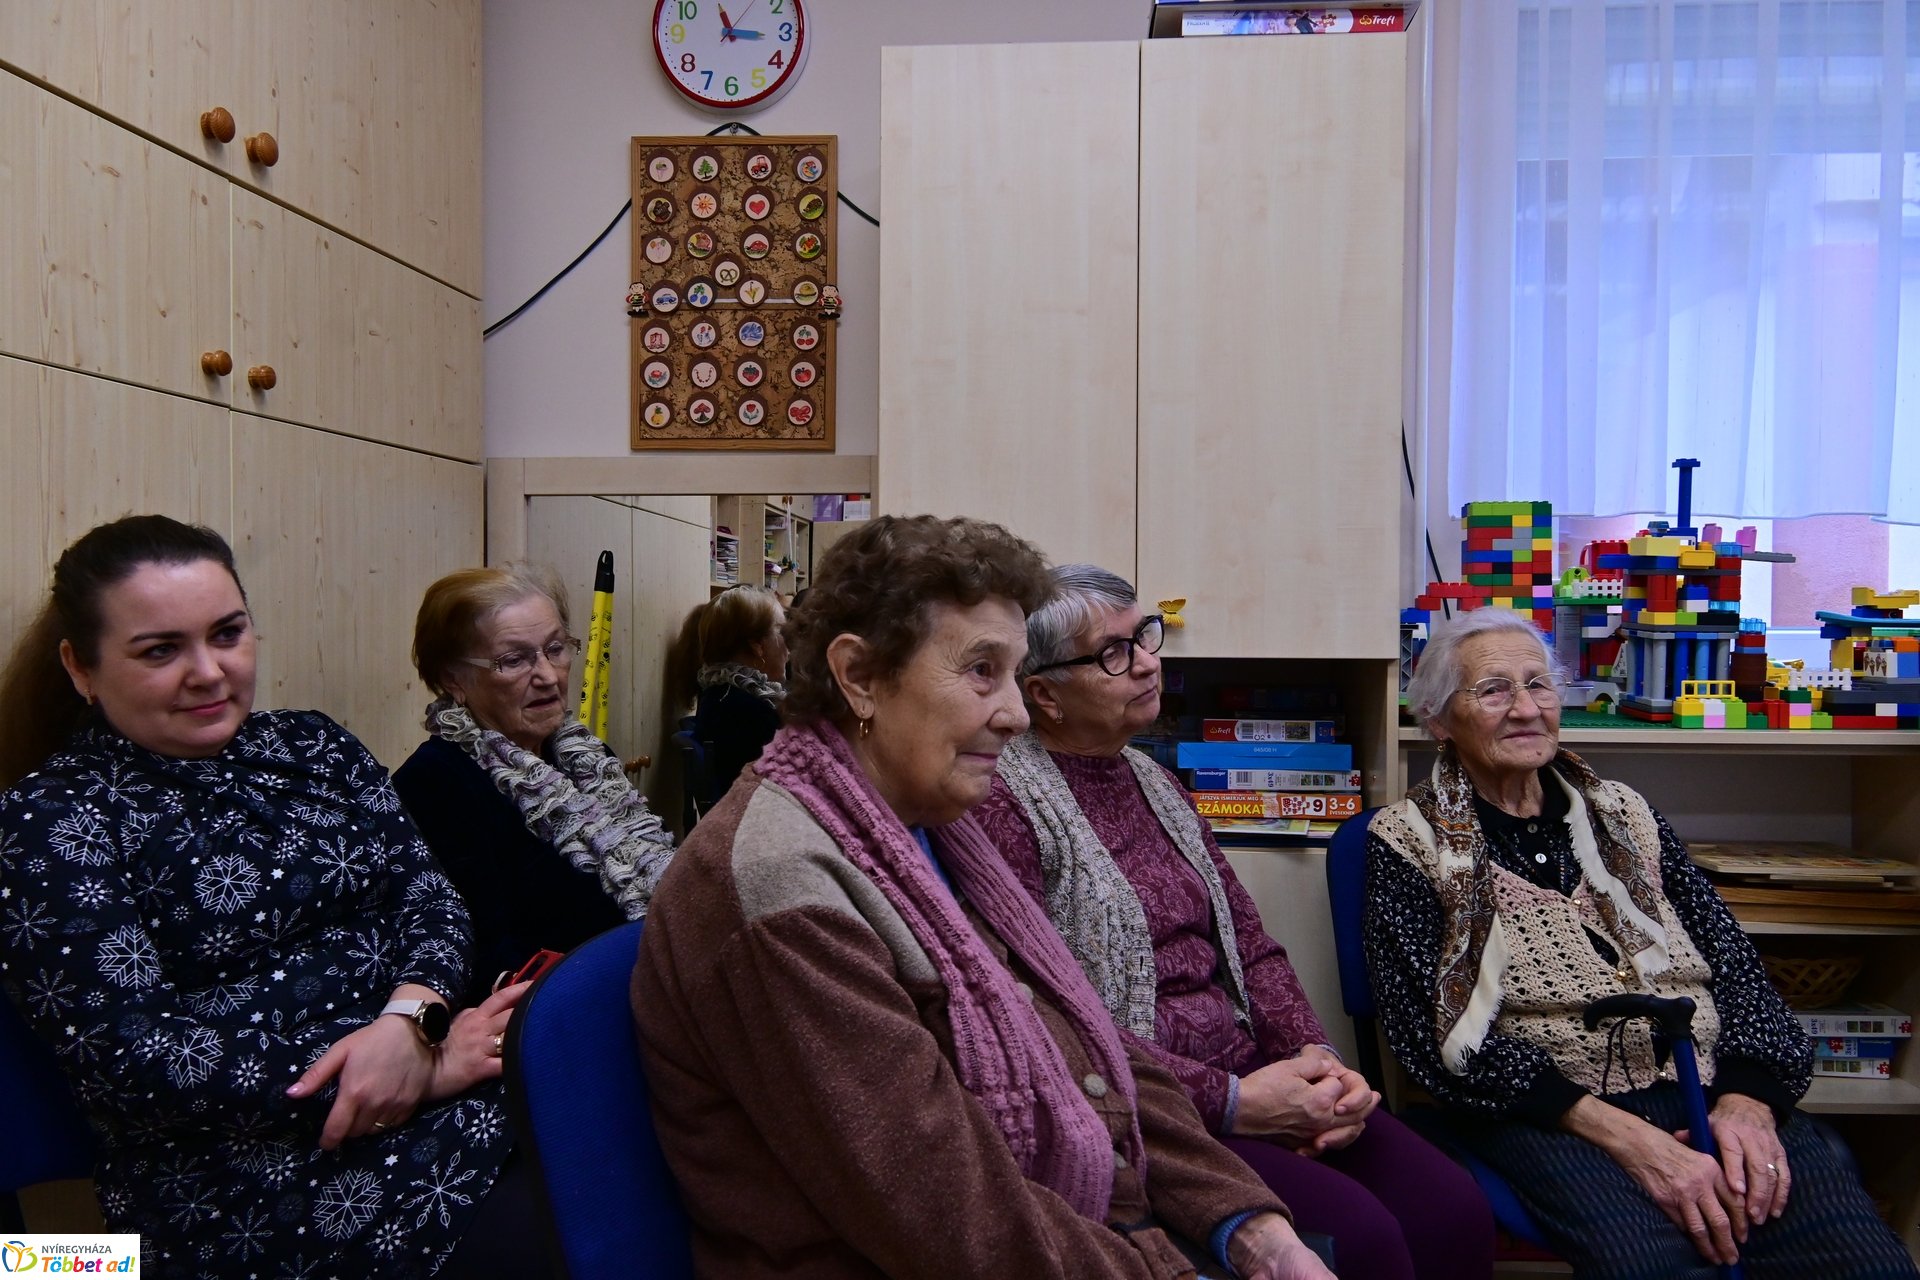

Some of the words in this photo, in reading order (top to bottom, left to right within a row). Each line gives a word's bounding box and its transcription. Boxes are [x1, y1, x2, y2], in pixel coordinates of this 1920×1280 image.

[678, 1, 697, 20] 10
[769, 0, 783, 14] 2
[1372, 15, 1395, 26] Trefl
[670, 24, 686, 44] 9
[779, 22, 793, 41] 3
[681, 53, 696, 72] 8
[768, 50, 784, 69] 4
[701, 71, 714, 90] 7
[724, 76, 739, 96] 6
[752, 68, 766, 88] 5
[1217, 727, 1231, 735] Trefl
[1197, 801, 1266, 815] SZÁMOKAT
[1313, 799, 1323, 812] 9
